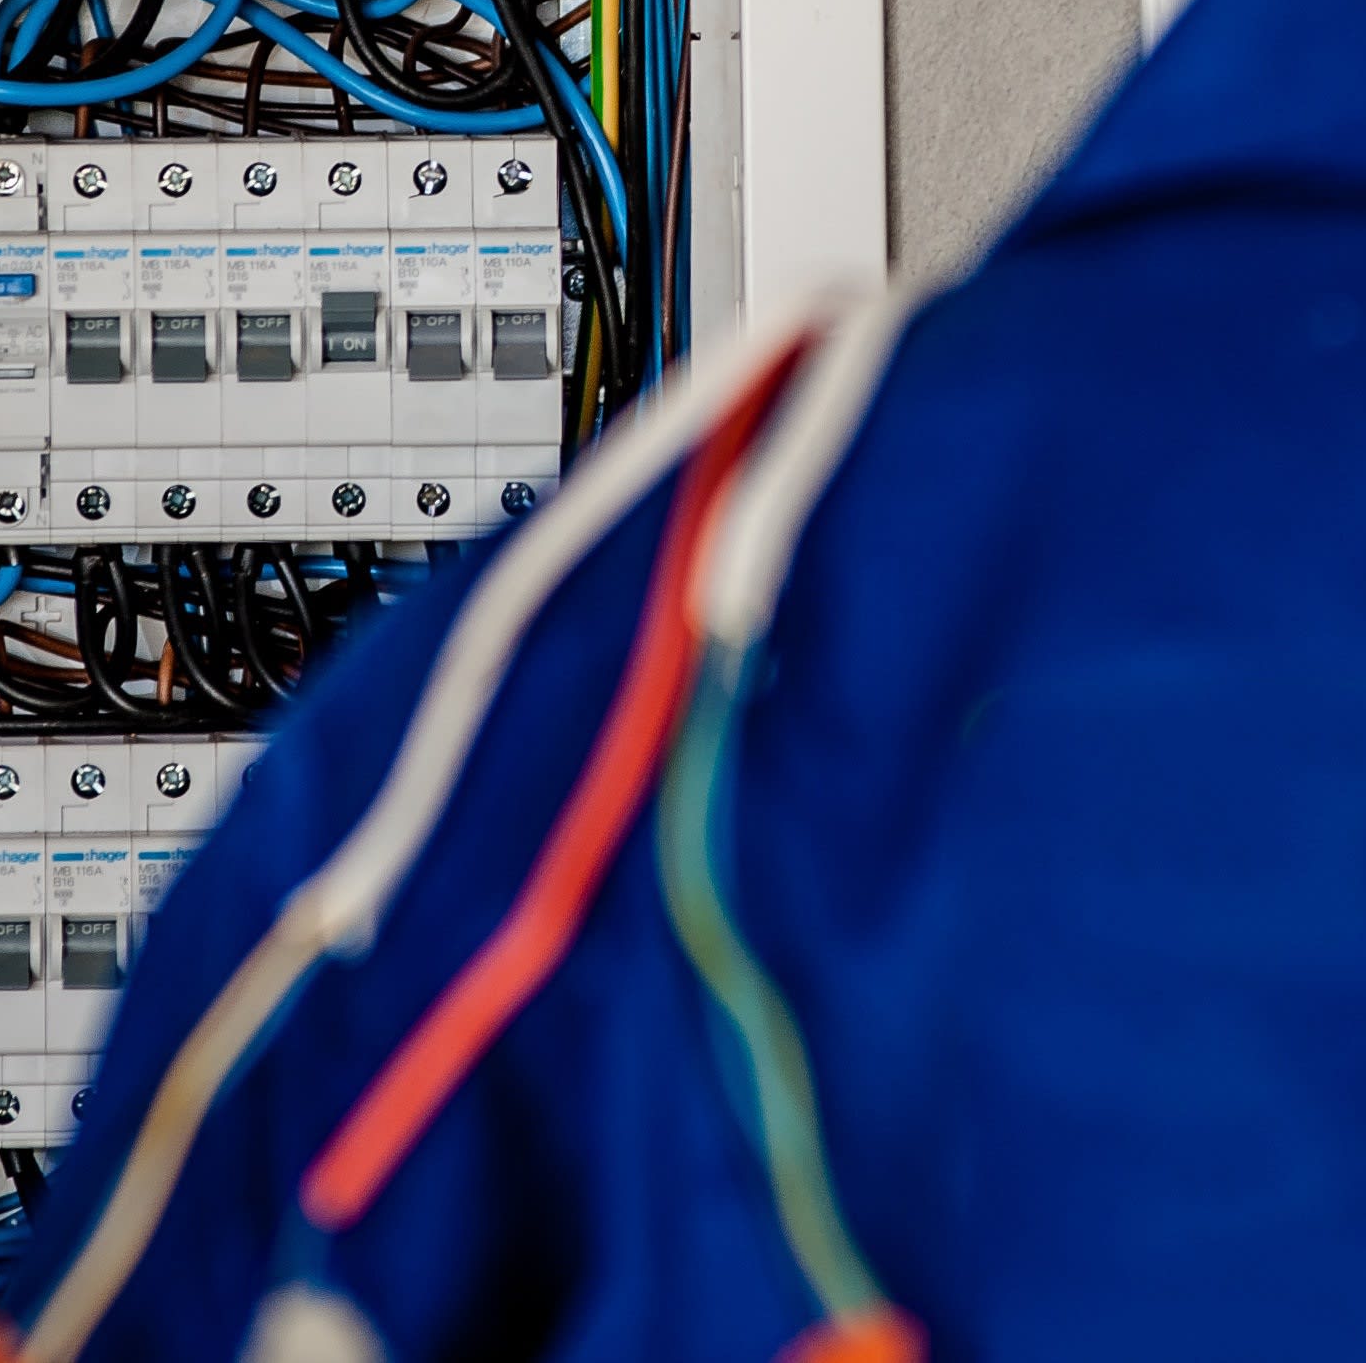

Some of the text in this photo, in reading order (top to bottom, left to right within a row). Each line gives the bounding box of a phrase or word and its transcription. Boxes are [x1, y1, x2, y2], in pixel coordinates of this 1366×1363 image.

[32, 153, 43, 164] N
[7, 243, 45, 257] hager
[91, 246, 130, 260] hager
[179, 245, 216, 260] hager
[264, 243, 301, 257] hager
[347, 243, 385, 257] hager
[433, 243, 470, 256] hager
[516, 242, 553, 256] hager
[79, 261, 106, 270] 116A
[164, 260, 191, 269] 116A
[250, 260, 276, 270] 116A
[332, 261, 358, 270] 116A
[420, 258, 447, 267] 110A
[506, 258, 531, 267] 110A
[85, 320, 115, 330] OFF
[170, 319, 201, 329] OFF
[255, 318, 286, 328] OFF
[426, 316, 456, 326] OFF
[511, 315, 542, 326] OFF
[343, 338, 368, 351] ON
[36, 514, 47, 526] N
[3, 850, 40, 864] hager
[90, 849, 129, 863] hager
[75, 866, 103, 876] 116A
[81, 923, 112, 935] OFF
